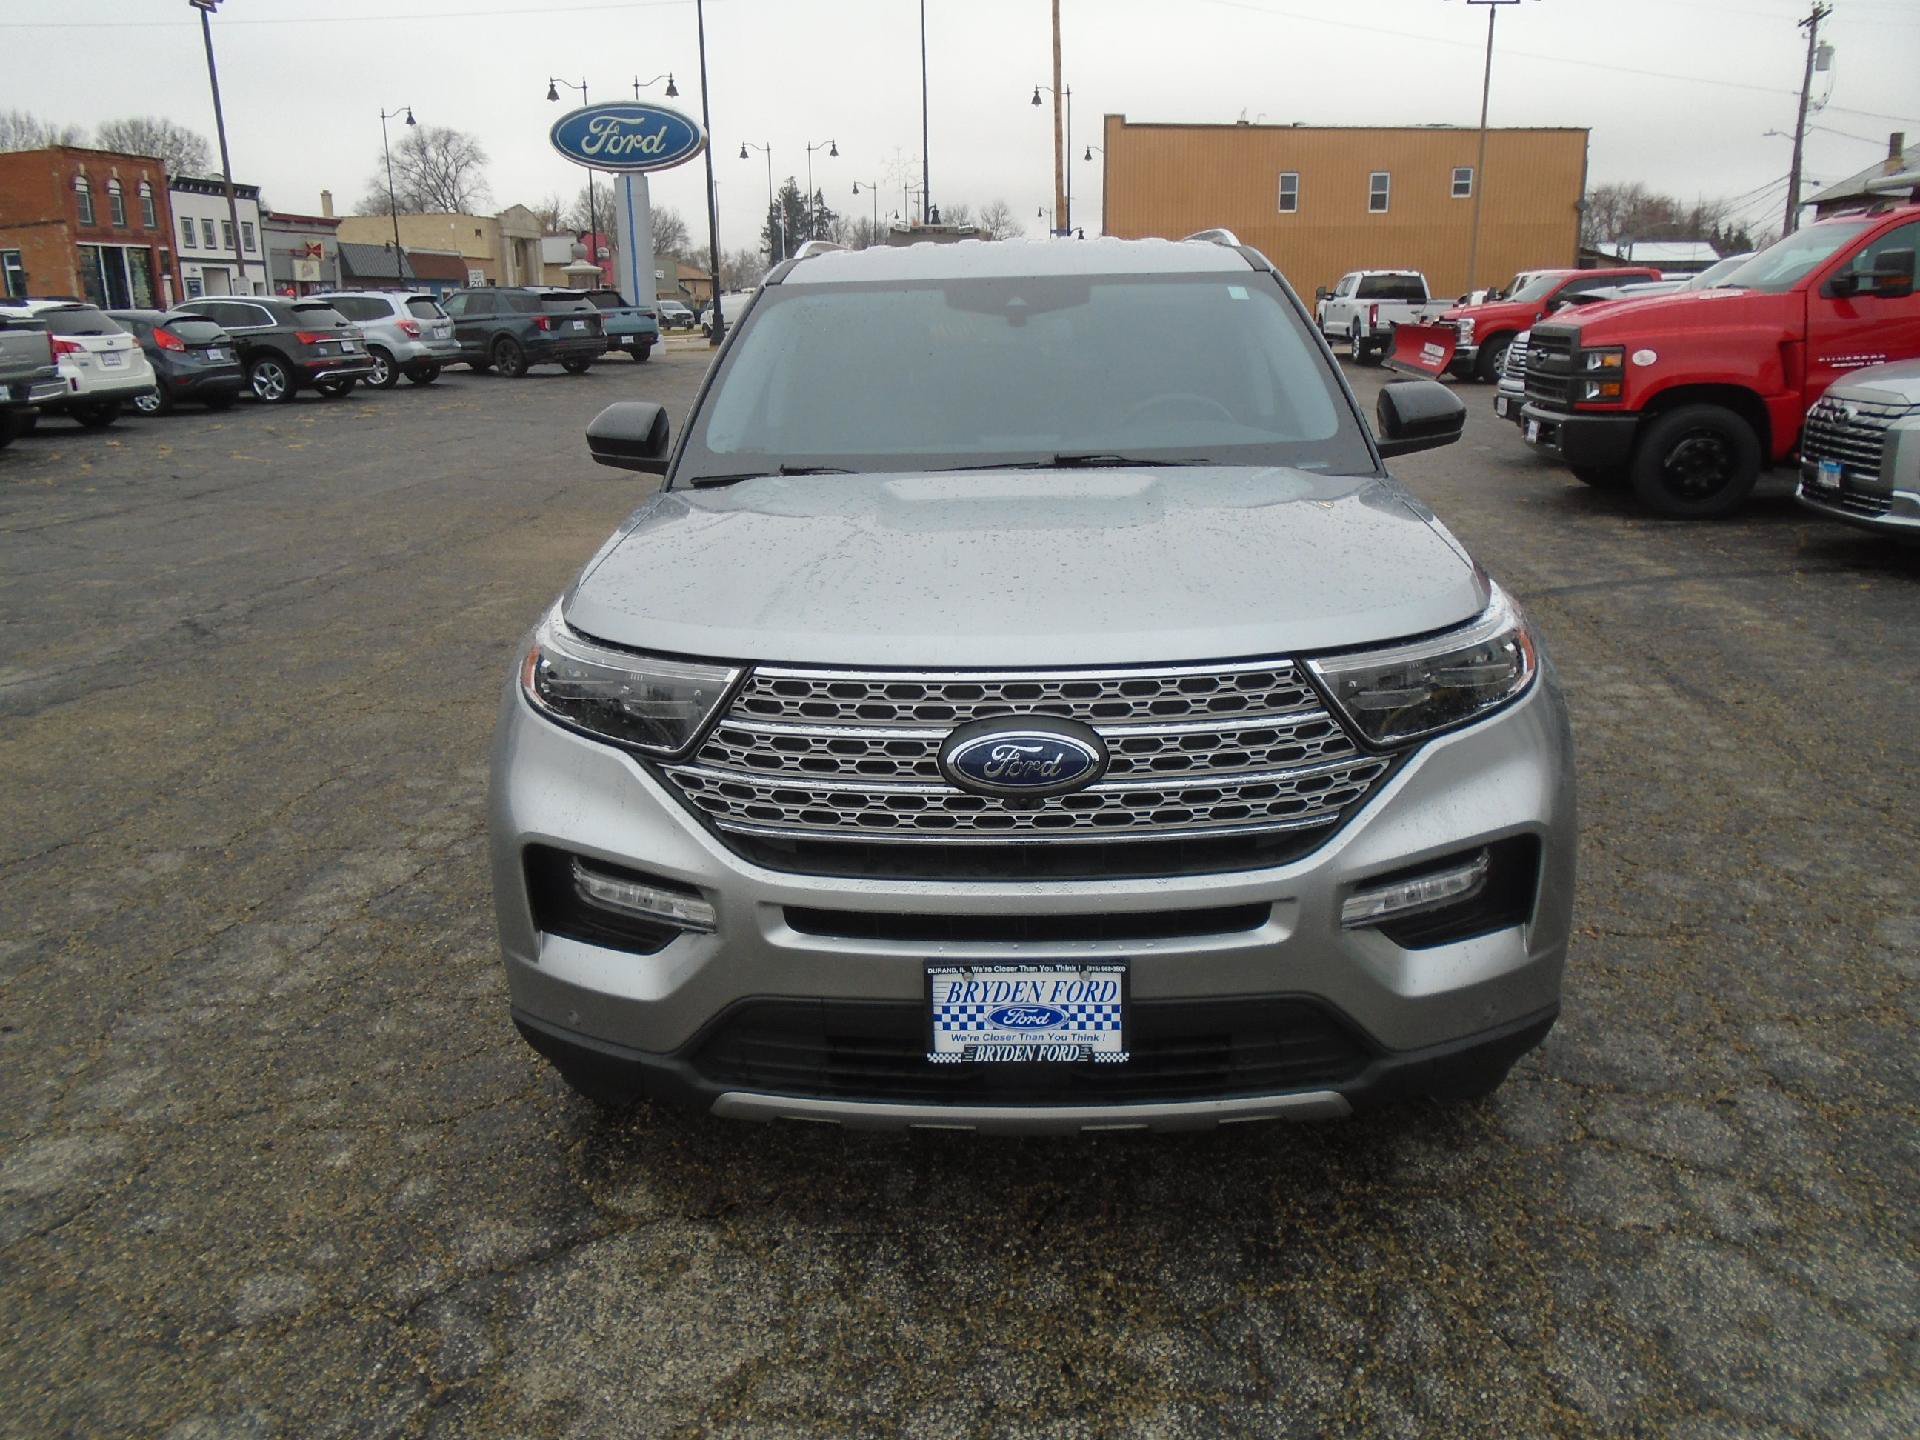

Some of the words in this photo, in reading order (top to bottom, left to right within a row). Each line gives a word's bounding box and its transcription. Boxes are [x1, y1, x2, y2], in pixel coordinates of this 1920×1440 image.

[581, 115, 667, 154] Ford
[983, 744, 1064, 777] Ford
[971, 965, 992, 973] We're
[994, 965, 1018, 973] Closer
[1019, 964, 1038, 972] Than
[1039, 964, 1054, 972] You
[1055, 964, 1077, 972] Think
[946, 980, 1045, 1004] BRYDEN
[1050, 980, 1118, 1003] FORD
[1003, 1008, 1050, 1025] Ford
[951, 1033, 980, 1042] We're
[982, 1033, 1017, 1042] Closer
[1019, 1032, 1045, 1041] Than
[1048, 1033, 1068, 1042] You
[1071, 1033, 1100, 1042] Think
[974, 1044, 1036, 1062] BRYDEN
[1037, 1044, 1080, 1062] FORD
